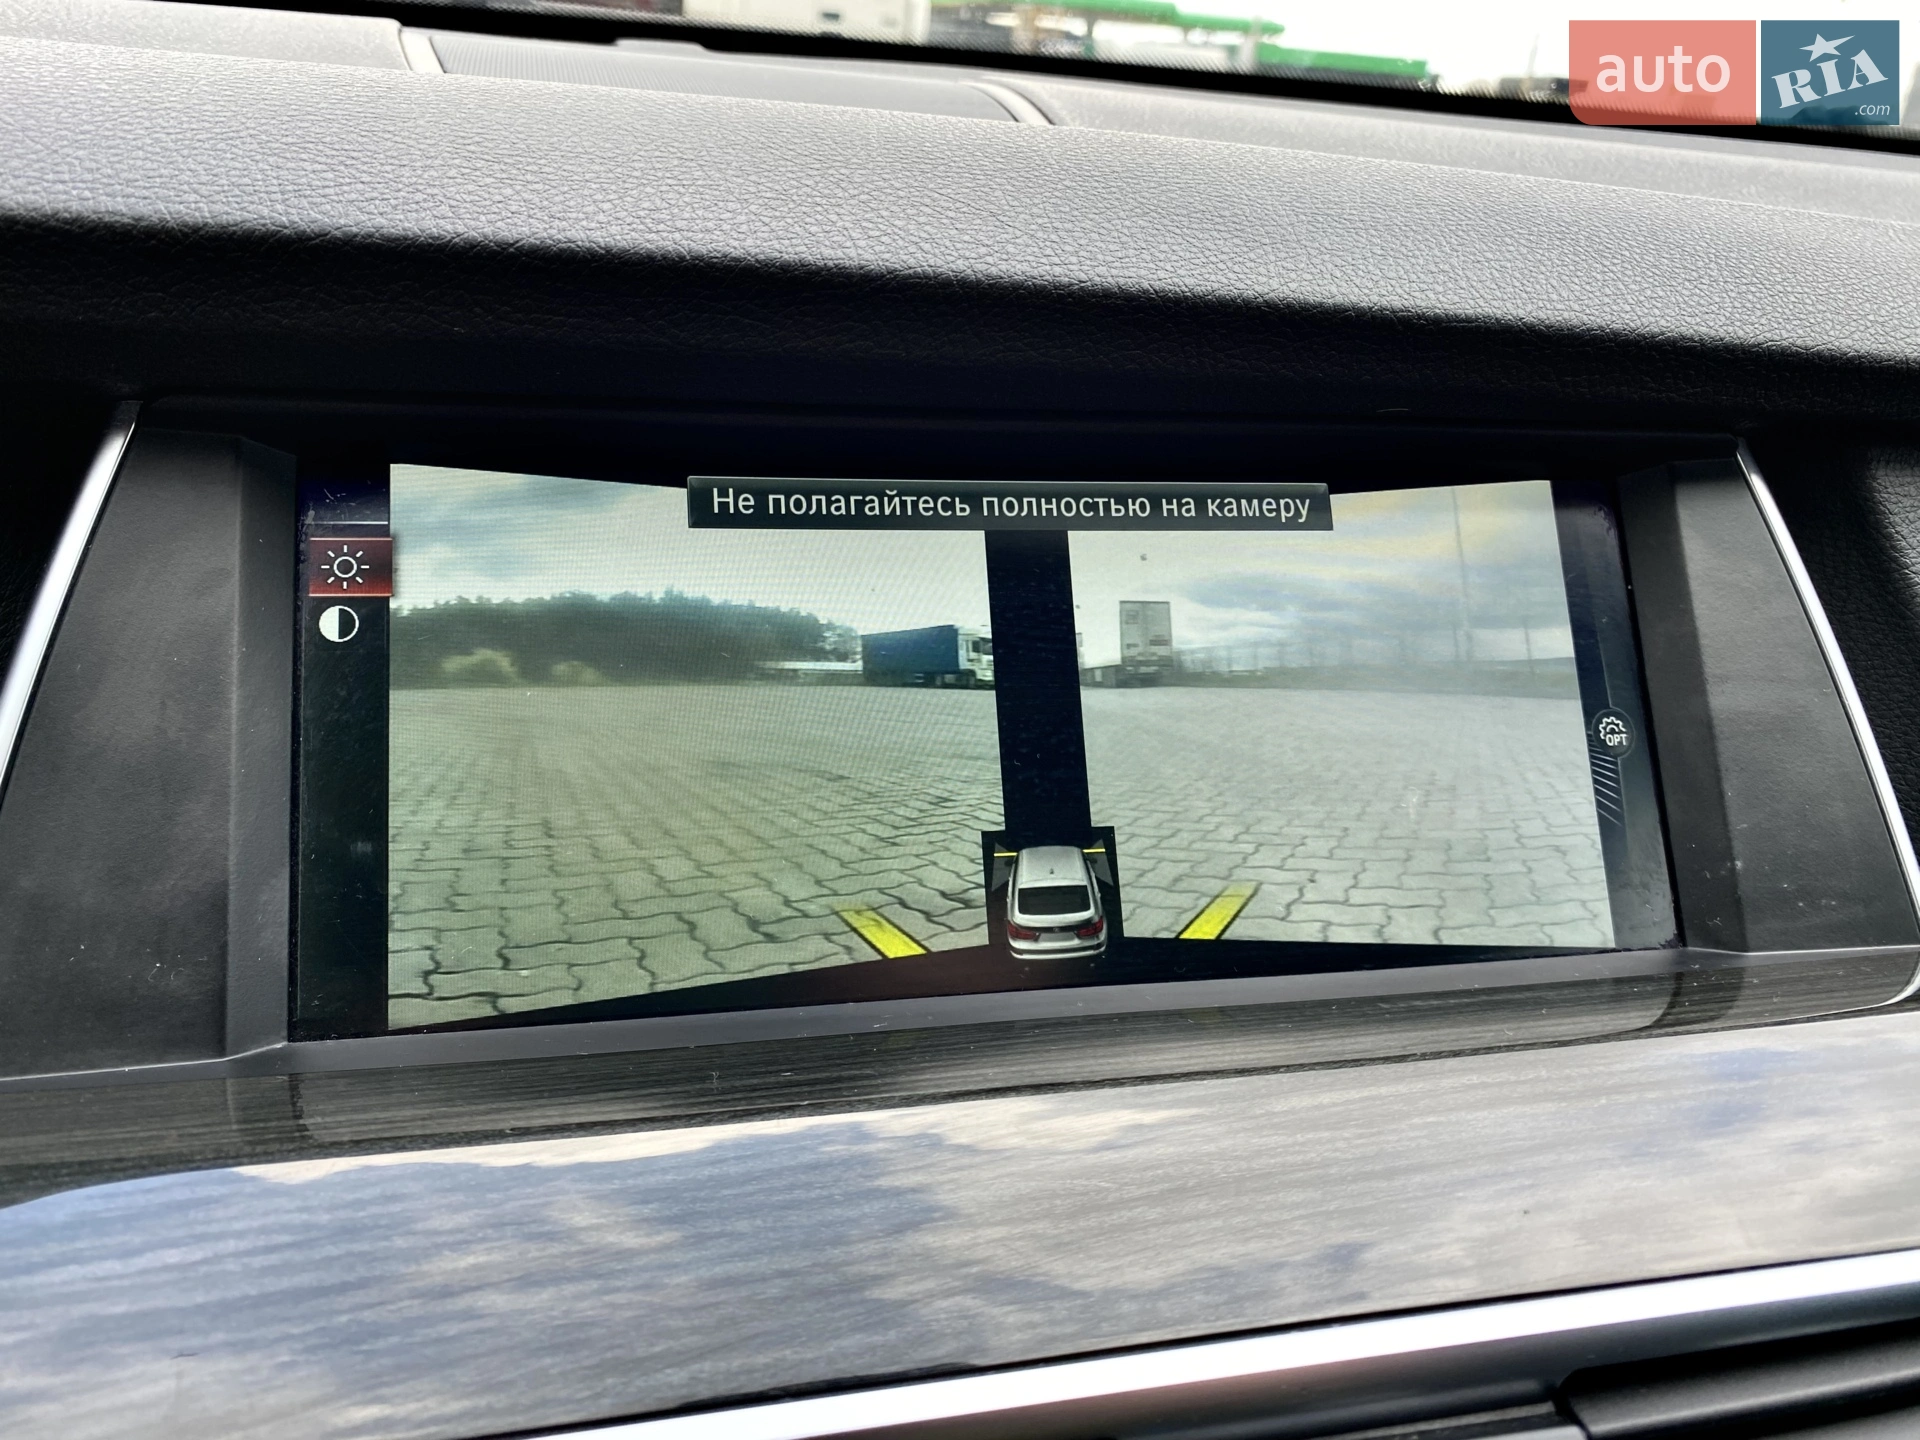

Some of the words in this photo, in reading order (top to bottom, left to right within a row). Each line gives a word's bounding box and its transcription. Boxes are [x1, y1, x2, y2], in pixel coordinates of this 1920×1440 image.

[711, 487, 755, 515] Не
[768, 489, 971, 517] полагайтесь
[981, 496, 1151, 518] полностью
[1161, 497, 1196, 517] на
[1206, 497, 1310, 522] камеру
[1605, 734, 1627, 746] OPT
